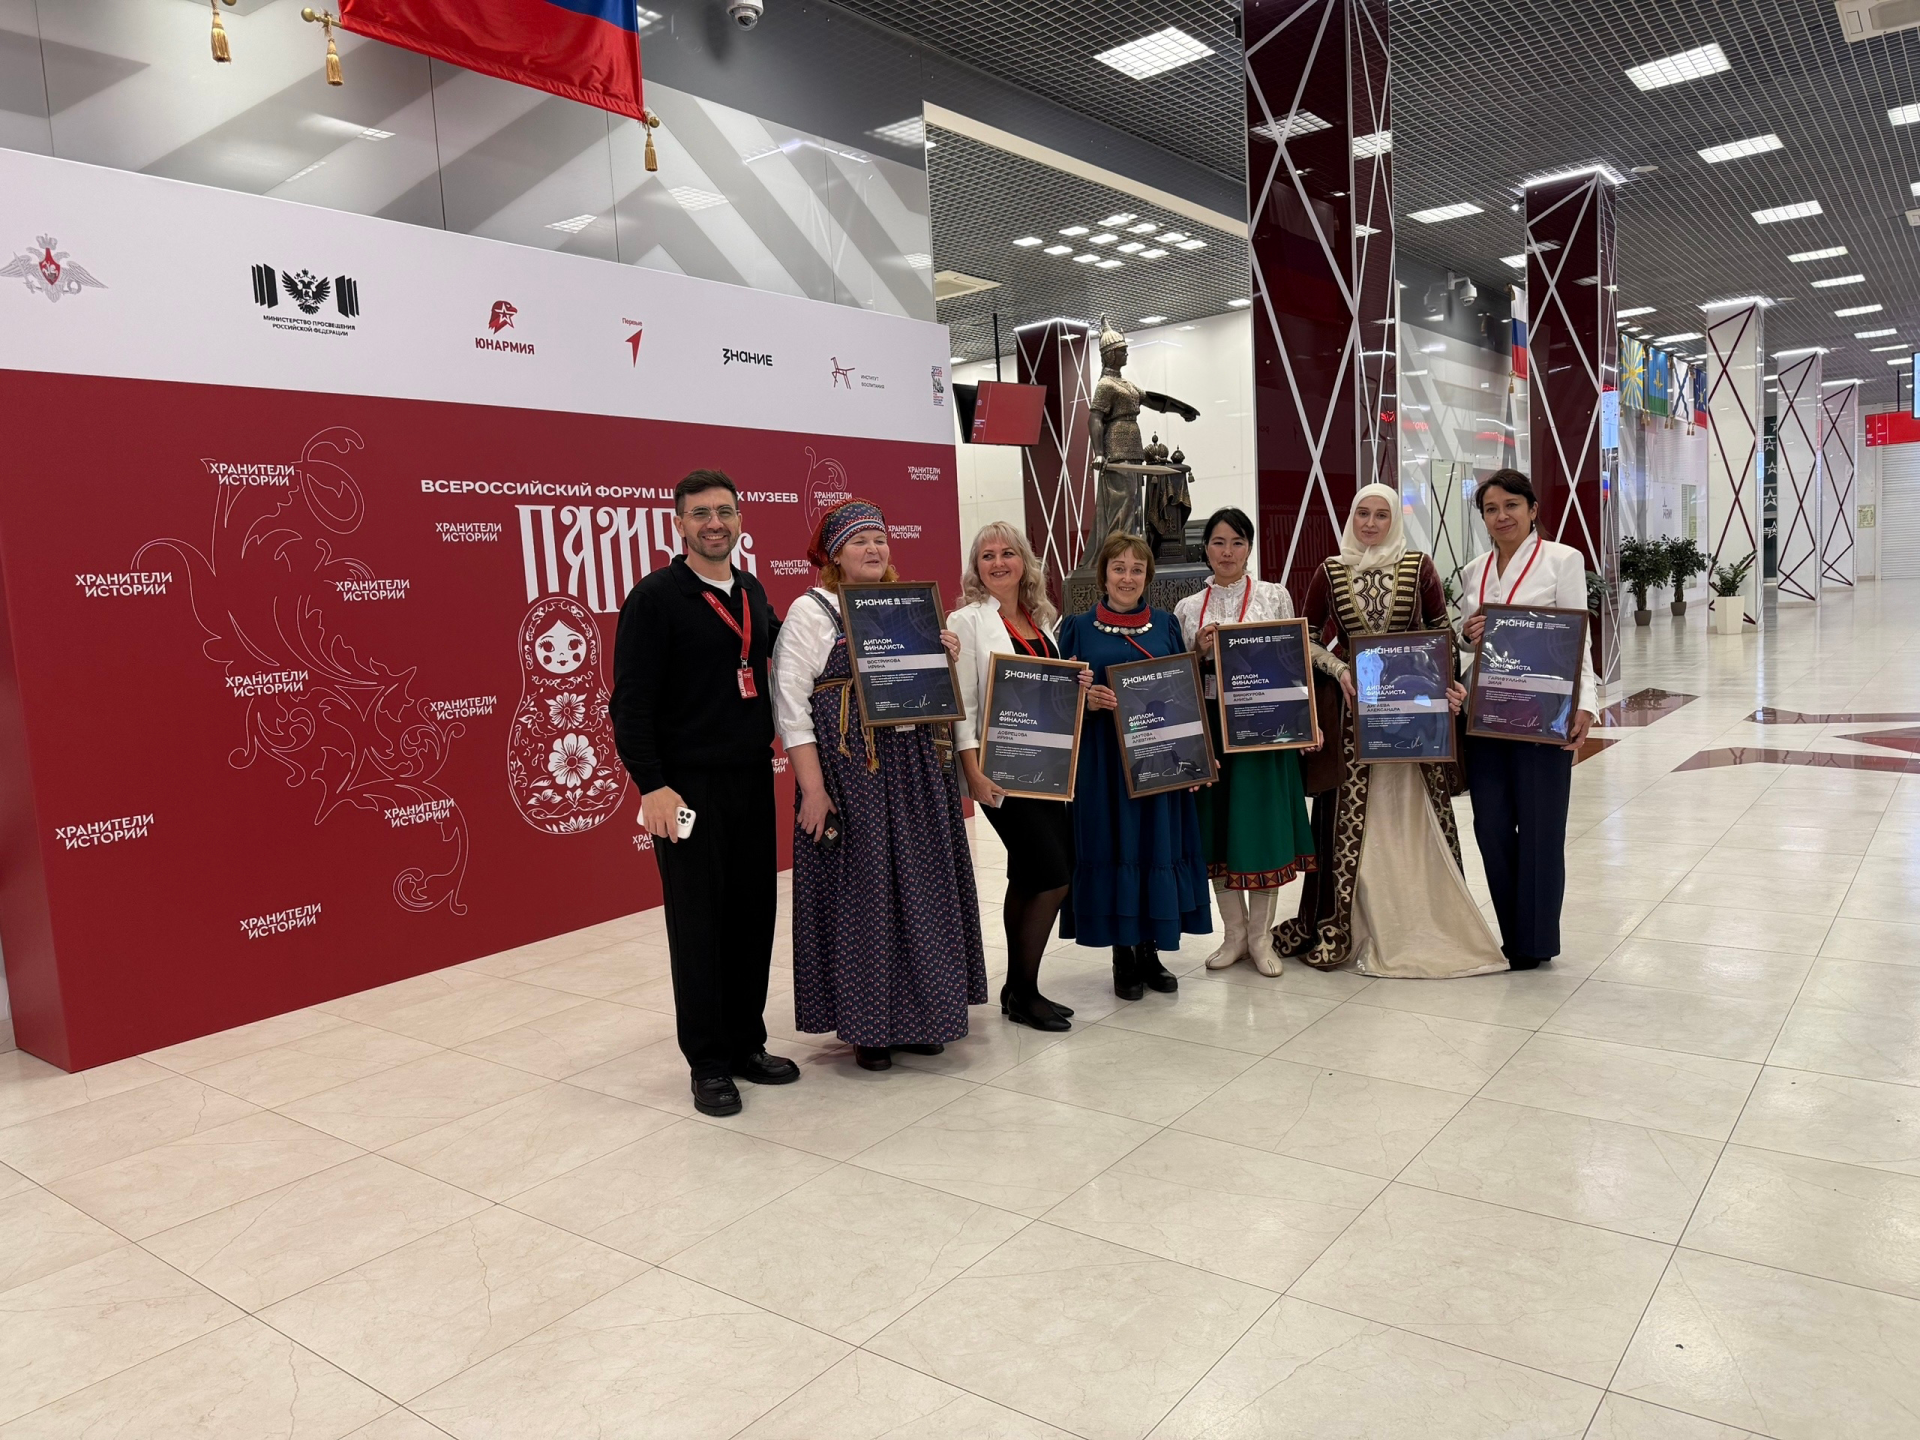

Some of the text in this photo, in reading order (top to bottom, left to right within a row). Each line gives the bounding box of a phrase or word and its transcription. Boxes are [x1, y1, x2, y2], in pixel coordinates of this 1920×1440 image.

[263, 315, 356, 331] МИНИСТЕРСТВО ПРОСВЕЩЕНИЯ
[622, 317, 643, 327] Первые
[272, 323, 349, 337] РОССИЙСКОЙ ФЕДЕРАЦИИ
[475, 337, 535, 356] ЮНАРМИЯ
[210, 462, 295, 476] ХРАНИТЕЛИ
[908, 466, 941, 475] ХРАНИТЕЛИ
[218, 474, 290, 487] ИСТОРИИ
[910, 473, 939, 481] ИСТОРИИ
[421, 479, 592, 498] ВСЕРОССИЙСКИЙ
[595, 484, 655, 500] ФОРУМ
[813, 491, 852, 500] ХРАНИТЕЛИ
[747, 491, 799, 504] МУЗЕЕВ
[436, 522, 502, 533] ХРАНИТЕЛИ
[888, 525, 921, 533] ХРАНИТЕЛИ
[442, 531, 498, 542] ИСТОРИИ
[770, 559, 812, 568] ХРАНИТЕЛИ
[774, 566, 809, 575] ИСТОРИИ
[75, 571, 173, 587] ХРАНИТЕЛИ
[336, 579, 410, 592] ХРАНИТЕЛИ
[84, 583, 167, 598] ИСТОРИИ
[343, 589, 405, 602] ИСТОРИИ
[863, 638, 892, 646] ДИПЛОМ
[226, 670, 309, 687] ХРАНИТЕЛИ
[1231, 678, 1270, 686] ФИНАЛИСТА
[233, 681, 304, 698] ИСТОРИИ
[430, 695, 497, 712] ХРАНИТЕЛИ
[436, 706, 493, 720] ИСТОРИИ
[999, 710, 1028, 718] ДИПЛОМ
[1129, 712, 1155, 722] ДИПЛОМ
[998, 716, 1038, 725] ФИНАЛИСТА
[1129, 716, 1165, 727] ФИНАЛИСТА
[384, 798, 455, 820] ХРАНИТЕЛИ
[391, 809, 450, 828] ИСТОРИИ
[55, 813, 155, 840] ХРАНИТЕЛИ
[65, 826, 149, 850] ИСТОРИИ
[239, 903, 322, 931] ХРАНИТЕЛИ
[248, 915, 317, 940] ИСТОРИИ
